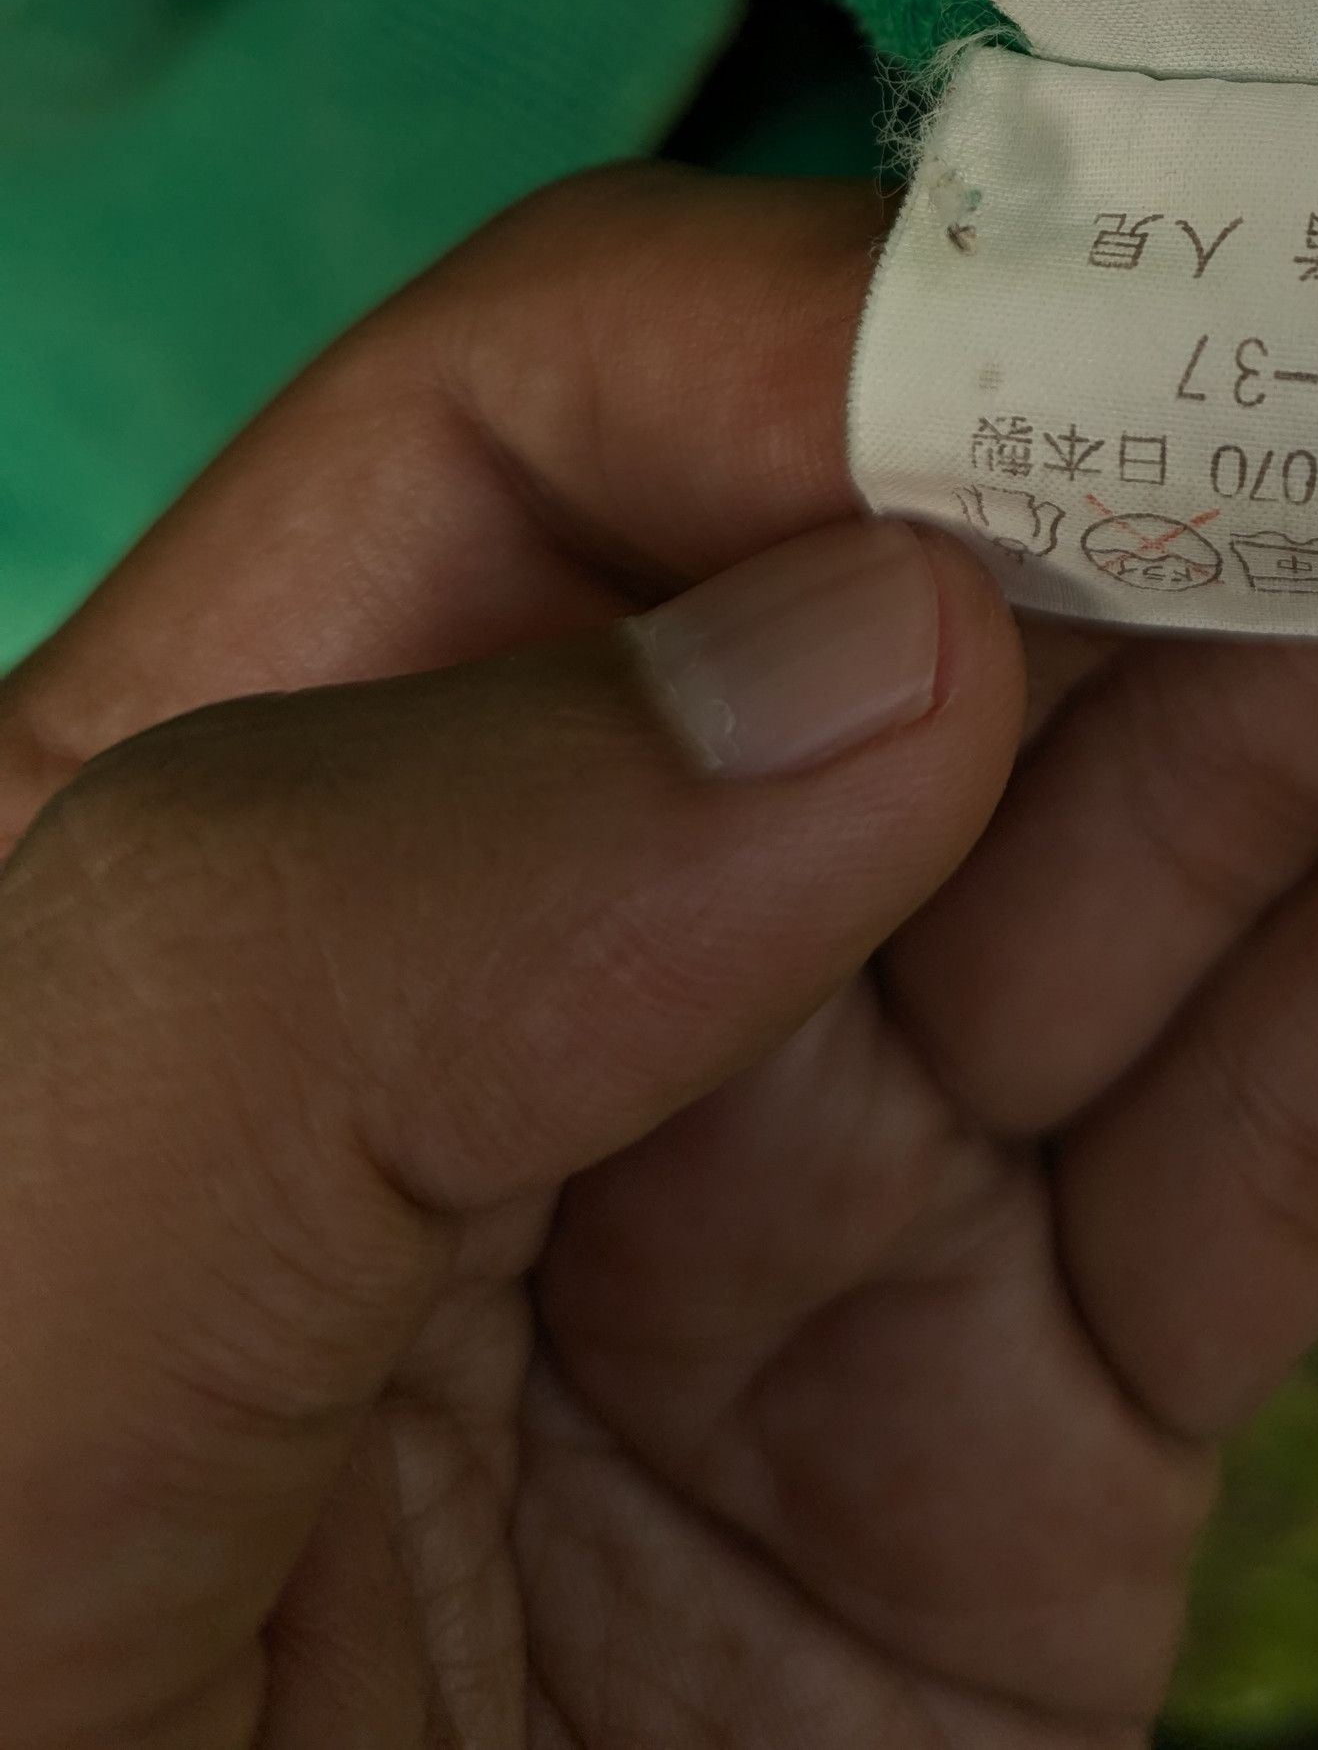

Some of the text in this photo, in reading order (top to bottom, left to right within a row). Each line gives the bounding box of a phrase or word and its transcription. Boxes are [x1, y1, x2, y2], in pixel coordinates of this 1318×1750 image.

[1086, 210, 1244, 280] 人見
[967, 414, 1168, 486] 日本製
